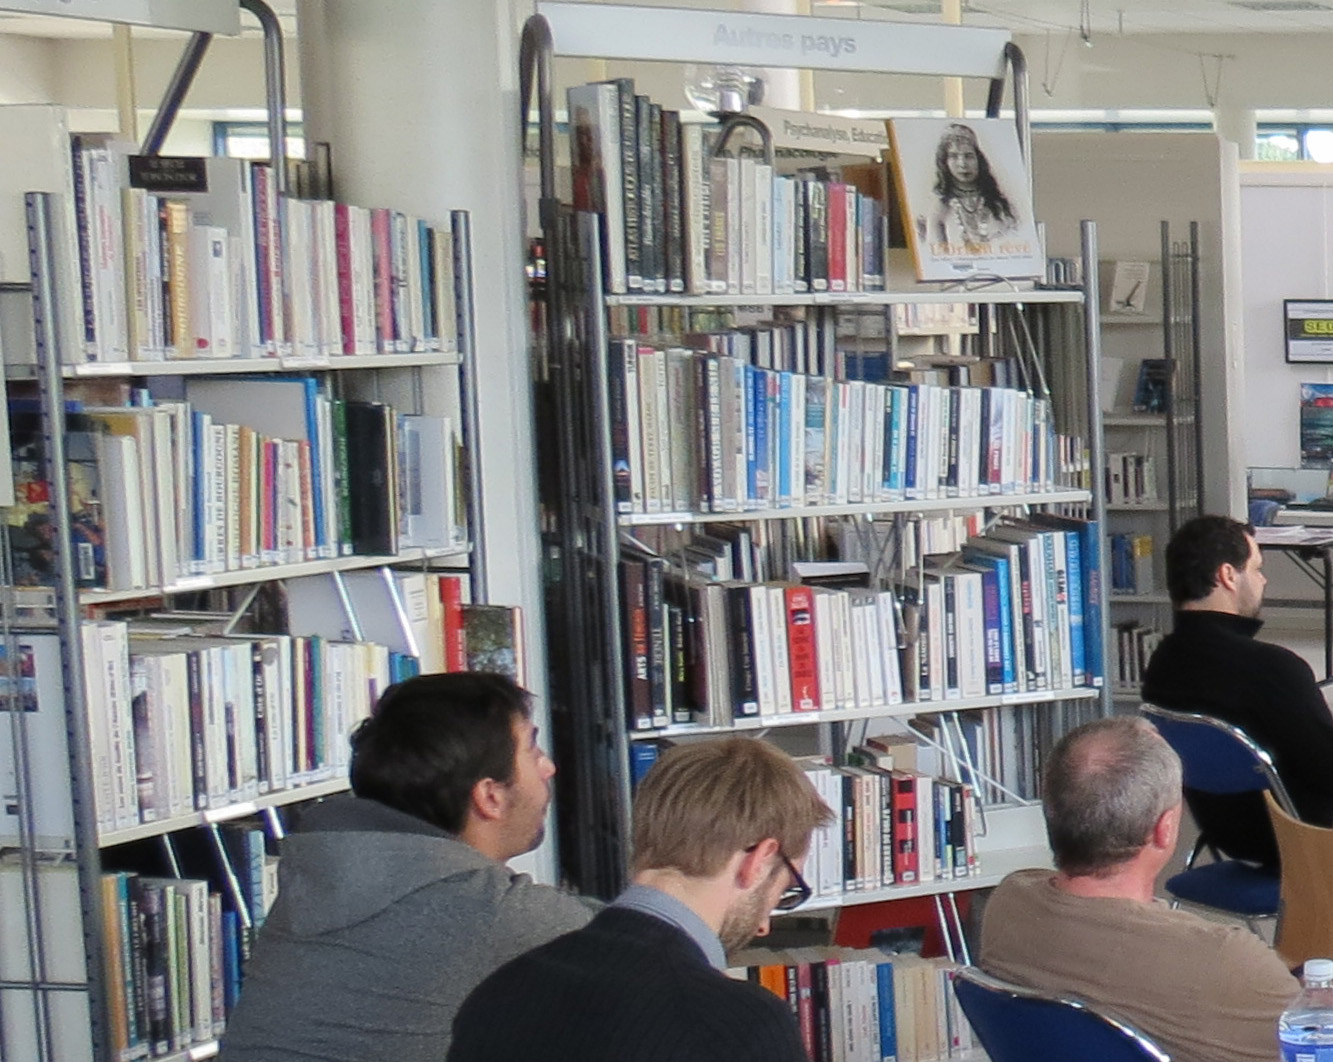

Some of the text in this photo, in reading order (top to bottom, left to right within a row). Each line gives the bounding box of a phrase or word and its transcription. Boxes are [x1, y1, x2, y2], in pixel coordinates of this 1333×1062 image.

[713, 24, 857, 58] Autres pays
[635, 655, 648, 680] ARTS
